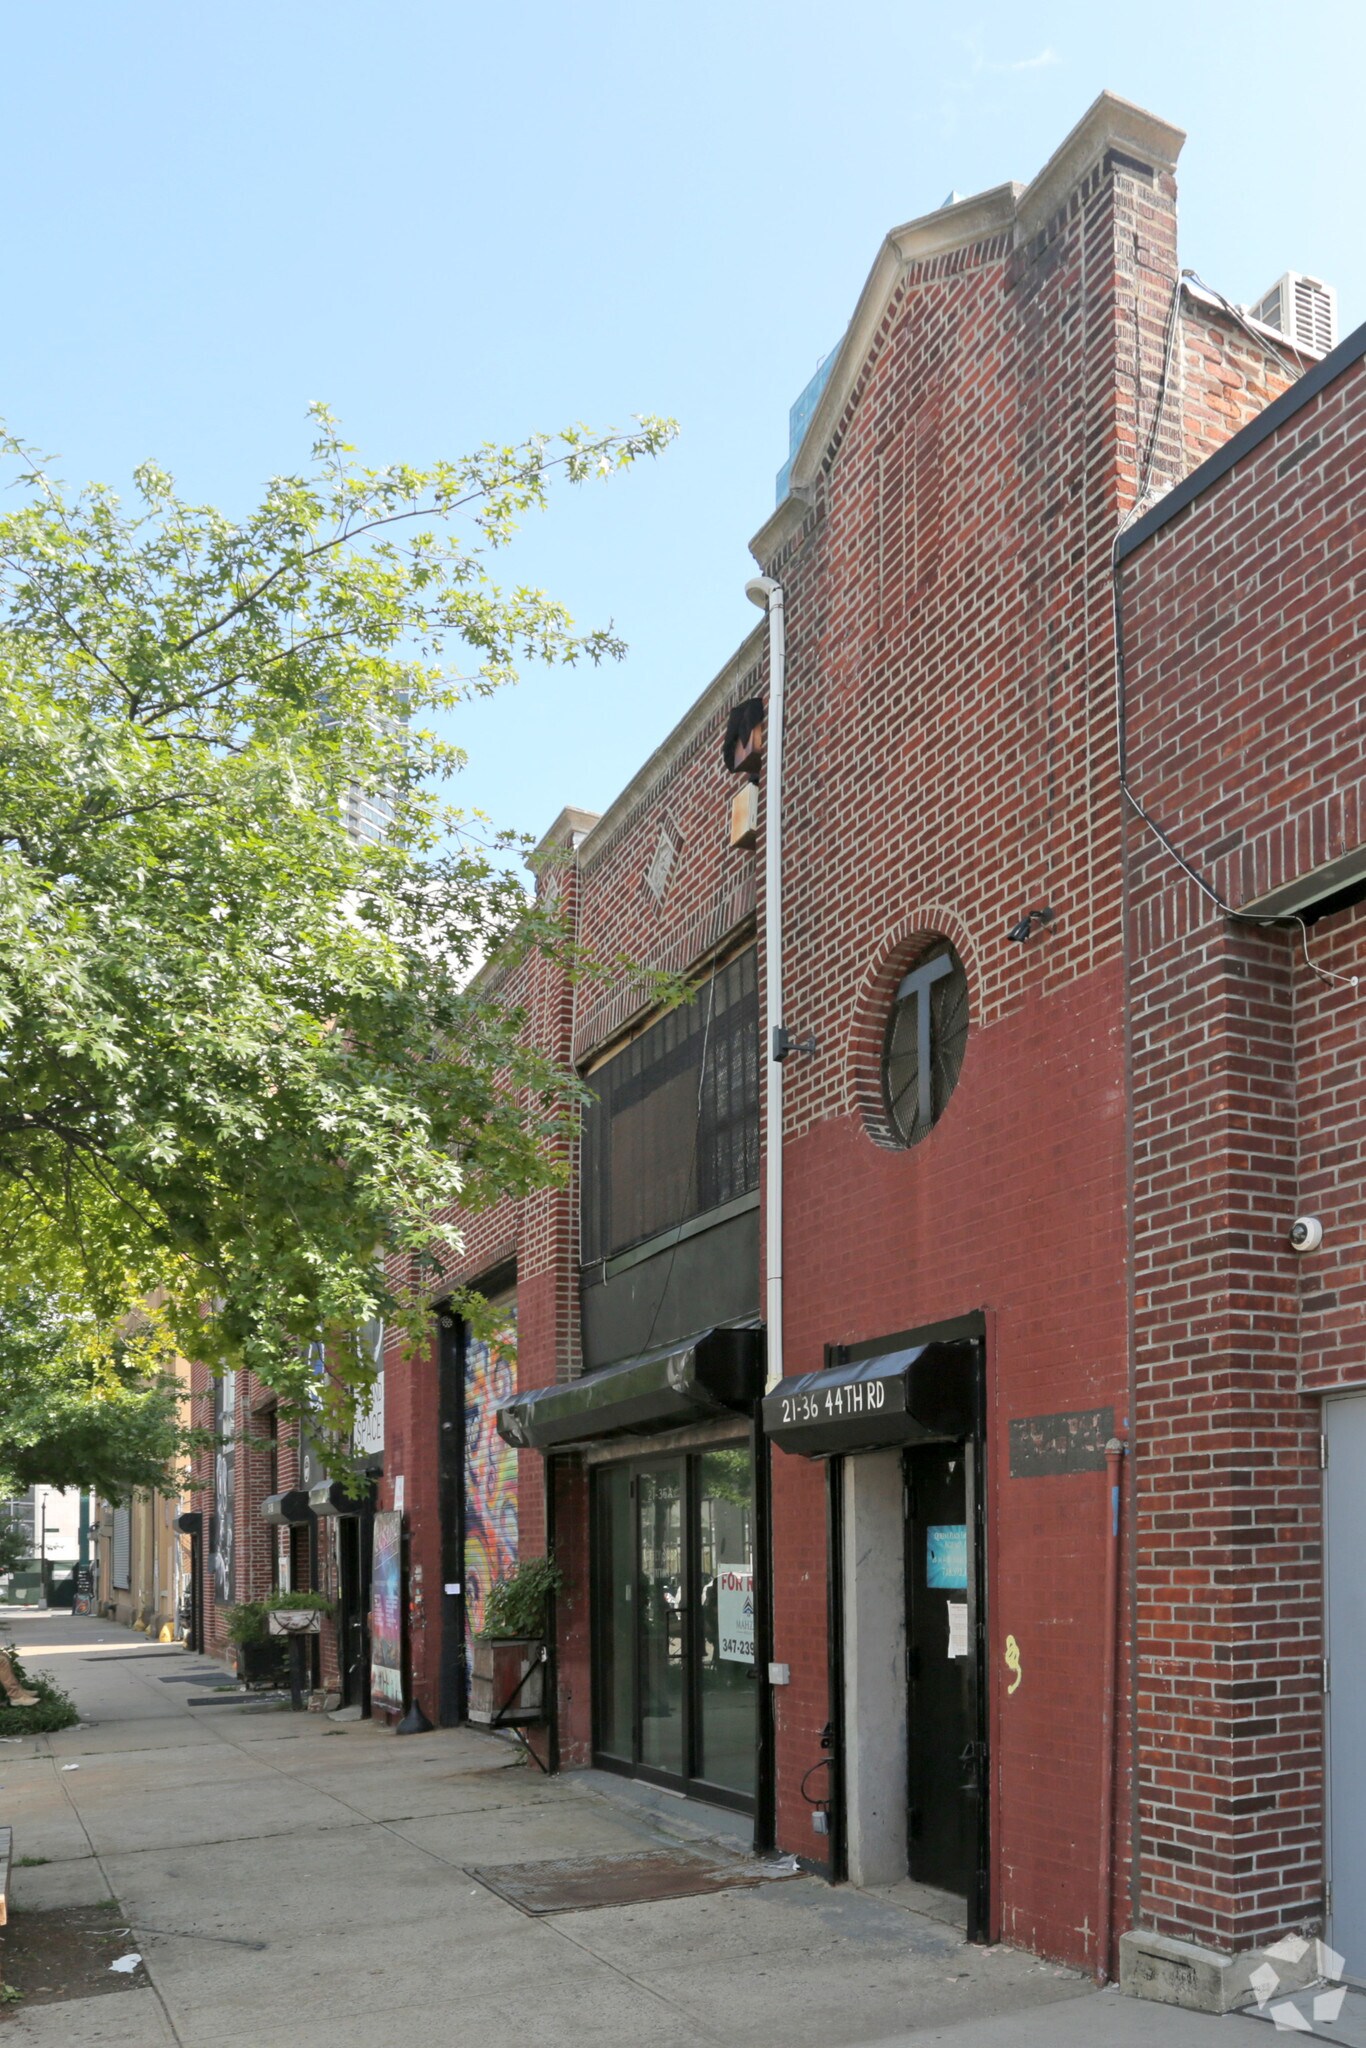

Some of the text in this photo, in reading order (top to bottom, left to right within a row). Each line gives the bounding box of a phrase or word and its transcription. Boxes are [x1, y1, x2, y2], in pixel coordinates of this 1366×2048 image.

[782, 1380, 885, 1423] 21-36 44TH RD
[357, 1411, 382, 1445] SPACE
[721, 1572, 743, 1592] FOR
